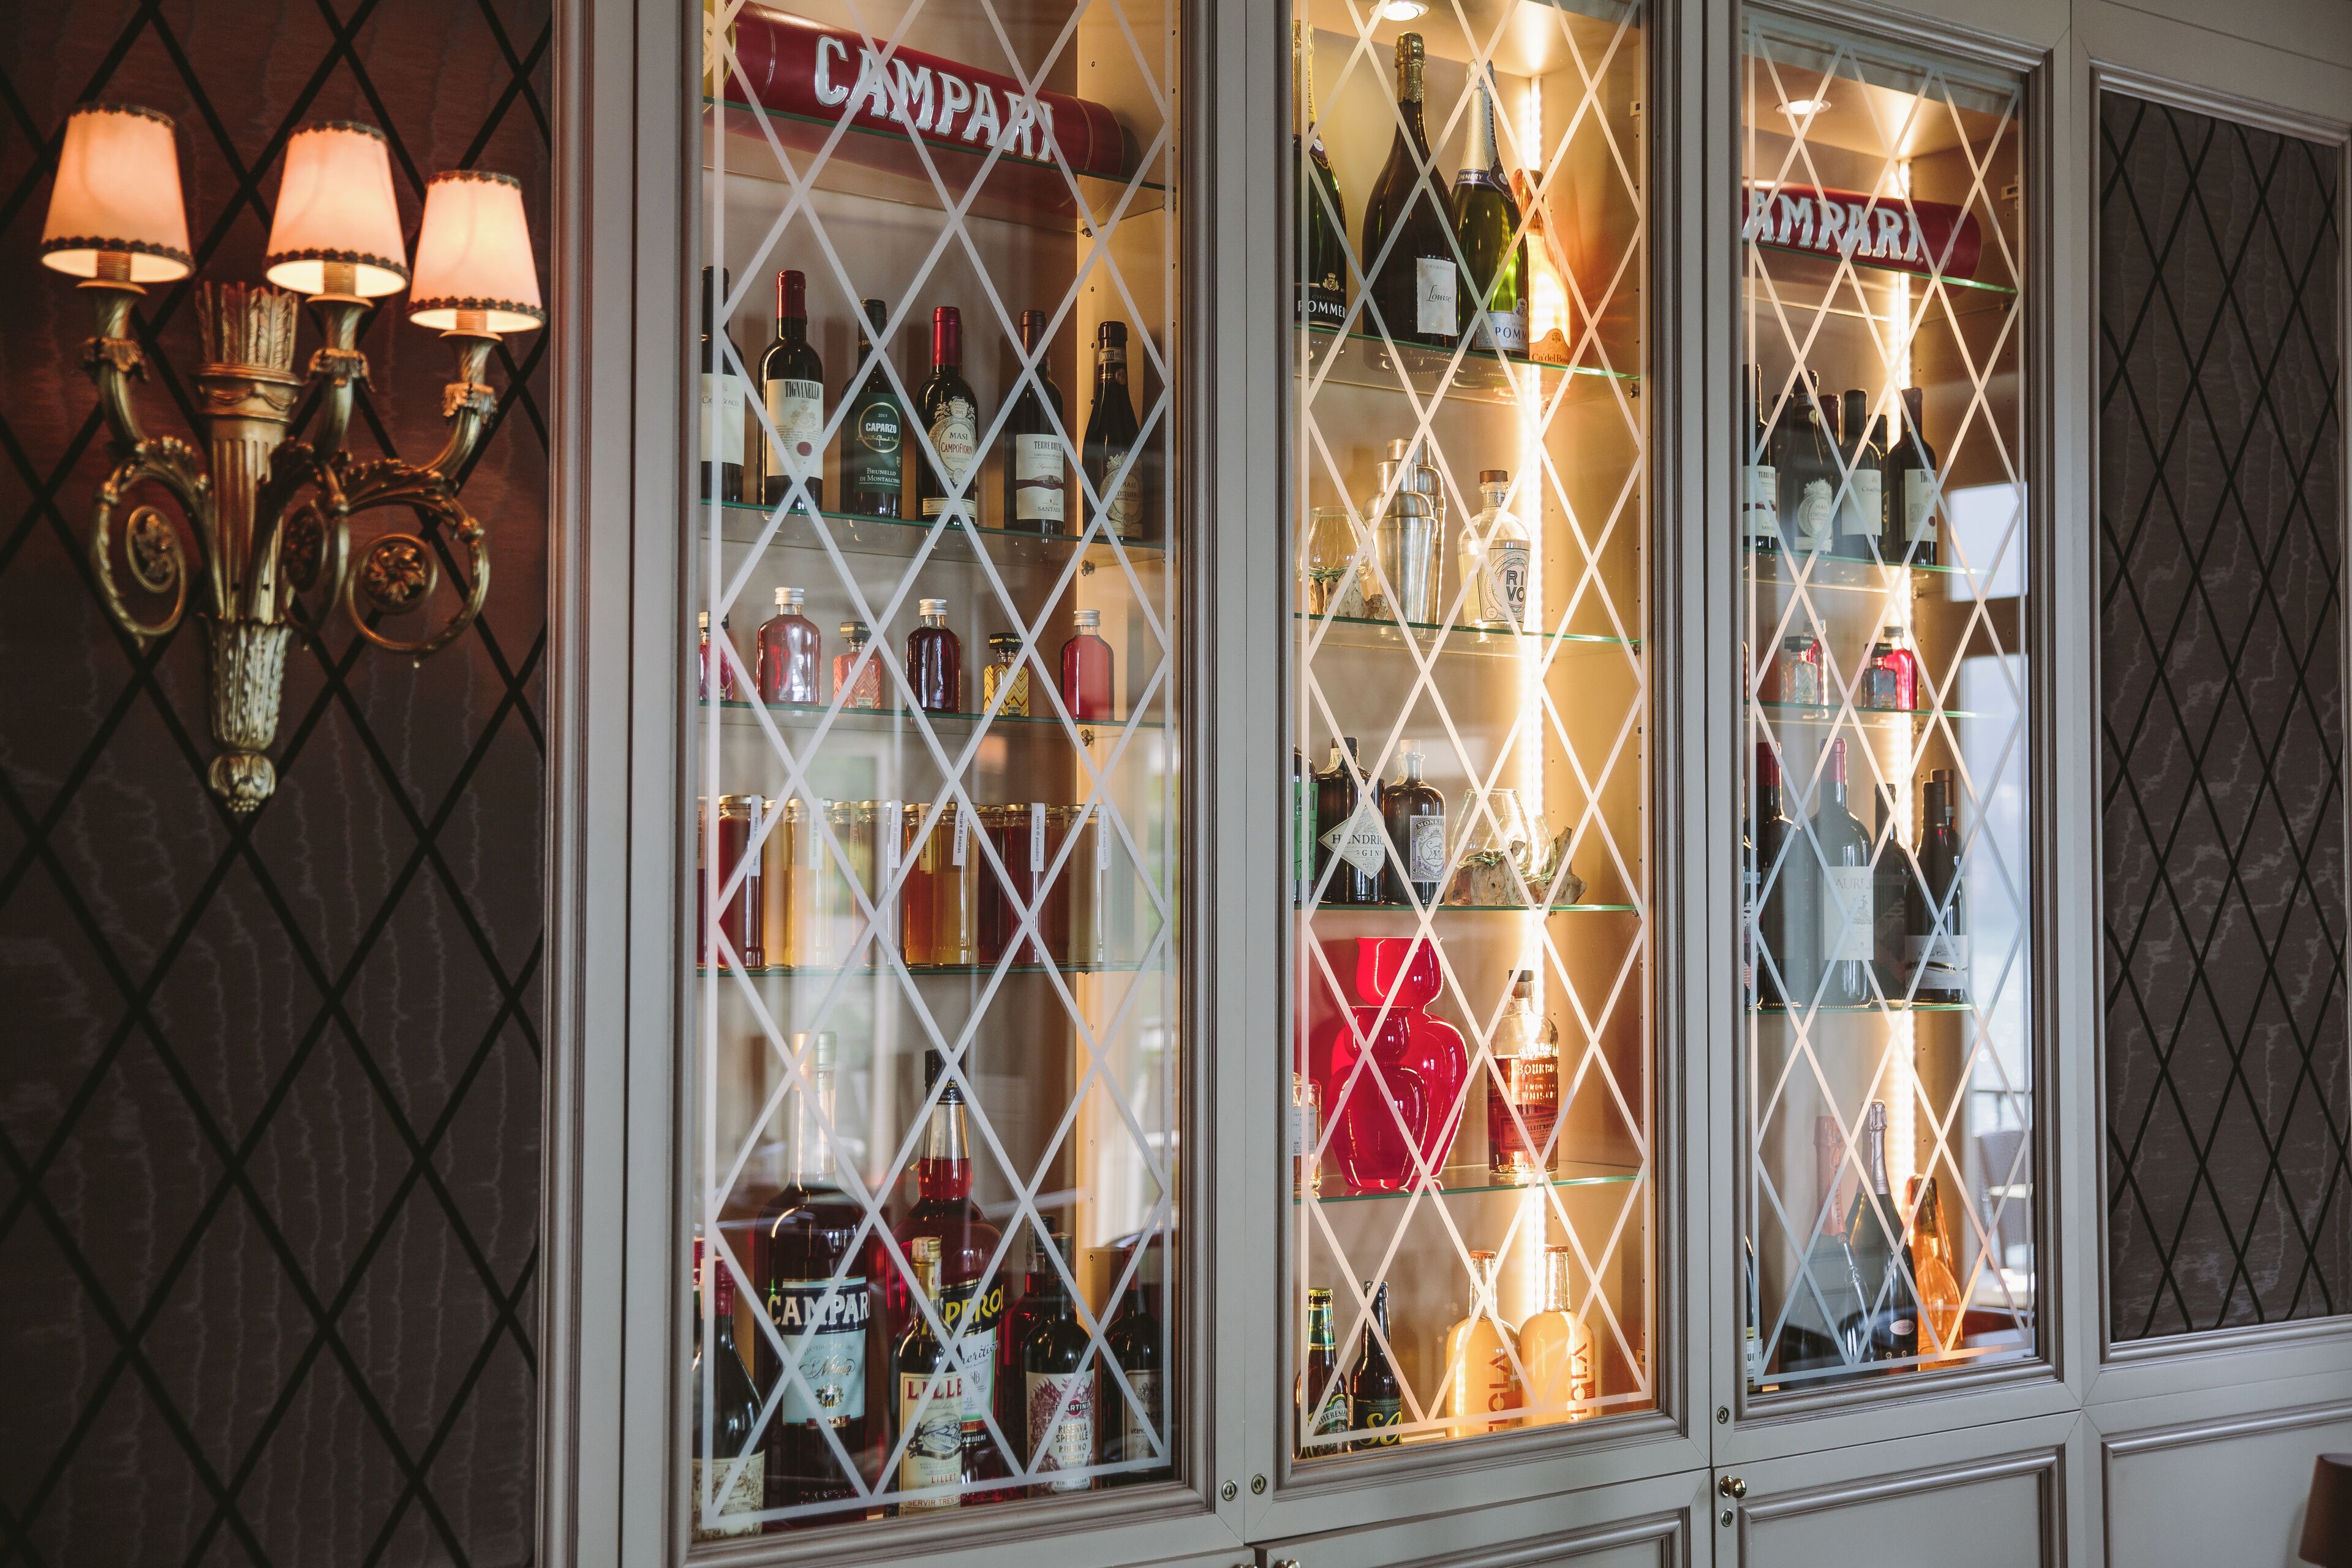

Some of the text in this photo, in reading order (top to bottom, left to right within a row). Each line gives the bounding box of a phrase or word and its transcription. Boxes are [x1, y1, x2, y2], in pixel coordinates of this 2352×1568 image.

[815, 34, 1054, 162] CAMPARI
[1743, 190, 1920, 263] AMPARI
[1426, 284, 1452, 303] Louise
[785, 381, 820, 400] TIGNANELLO
[865, 423, 897, 434] CAPARZO
[949, 432, 968, 440] MASI
[1058, 1422, 1087, 1434] RISERVA
[1058, 1443, 1087, 1453] RUBINO
[931, 1473, 956, 1483] LILLET
